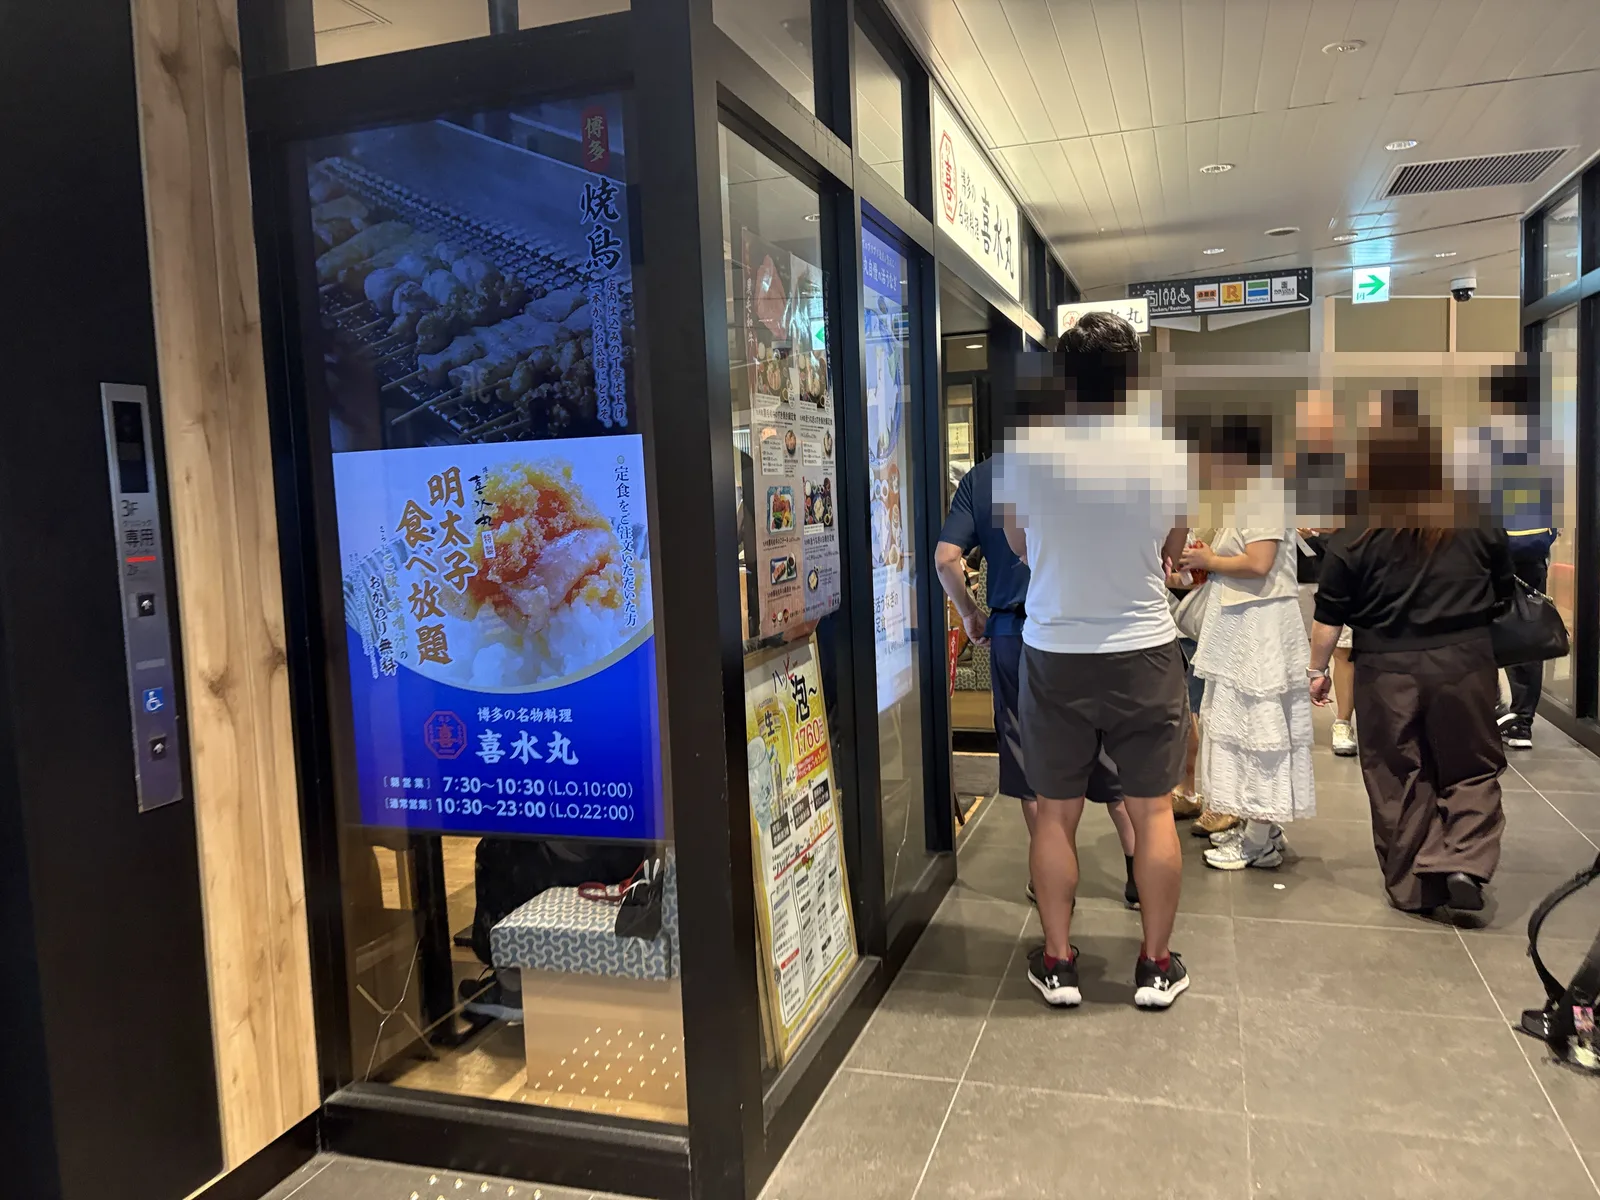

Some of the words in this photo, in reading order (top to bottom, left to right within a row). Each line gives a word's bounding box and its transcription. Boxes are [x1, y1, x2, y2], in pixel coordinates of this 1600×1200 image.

[585, 116, 605, 162] 博多
[580, 177, 622, 271] 焼鳥
[981, 187, 1015, 280] 喜水丸
[121, 500, 138, 517] 3F
[426, 466, 479, 596] 明太子
[615, 466, 637, 628] 定食をご注文いただいた方
[369, 575, 400, 677] おかわり無料
[396, 499, 453, 666] 食べ放題
[475, 728, 579, 765] 喜水丸
[476, 706, 573, 723] 博多の名物料理
[764, 709, 775, 737] 生
